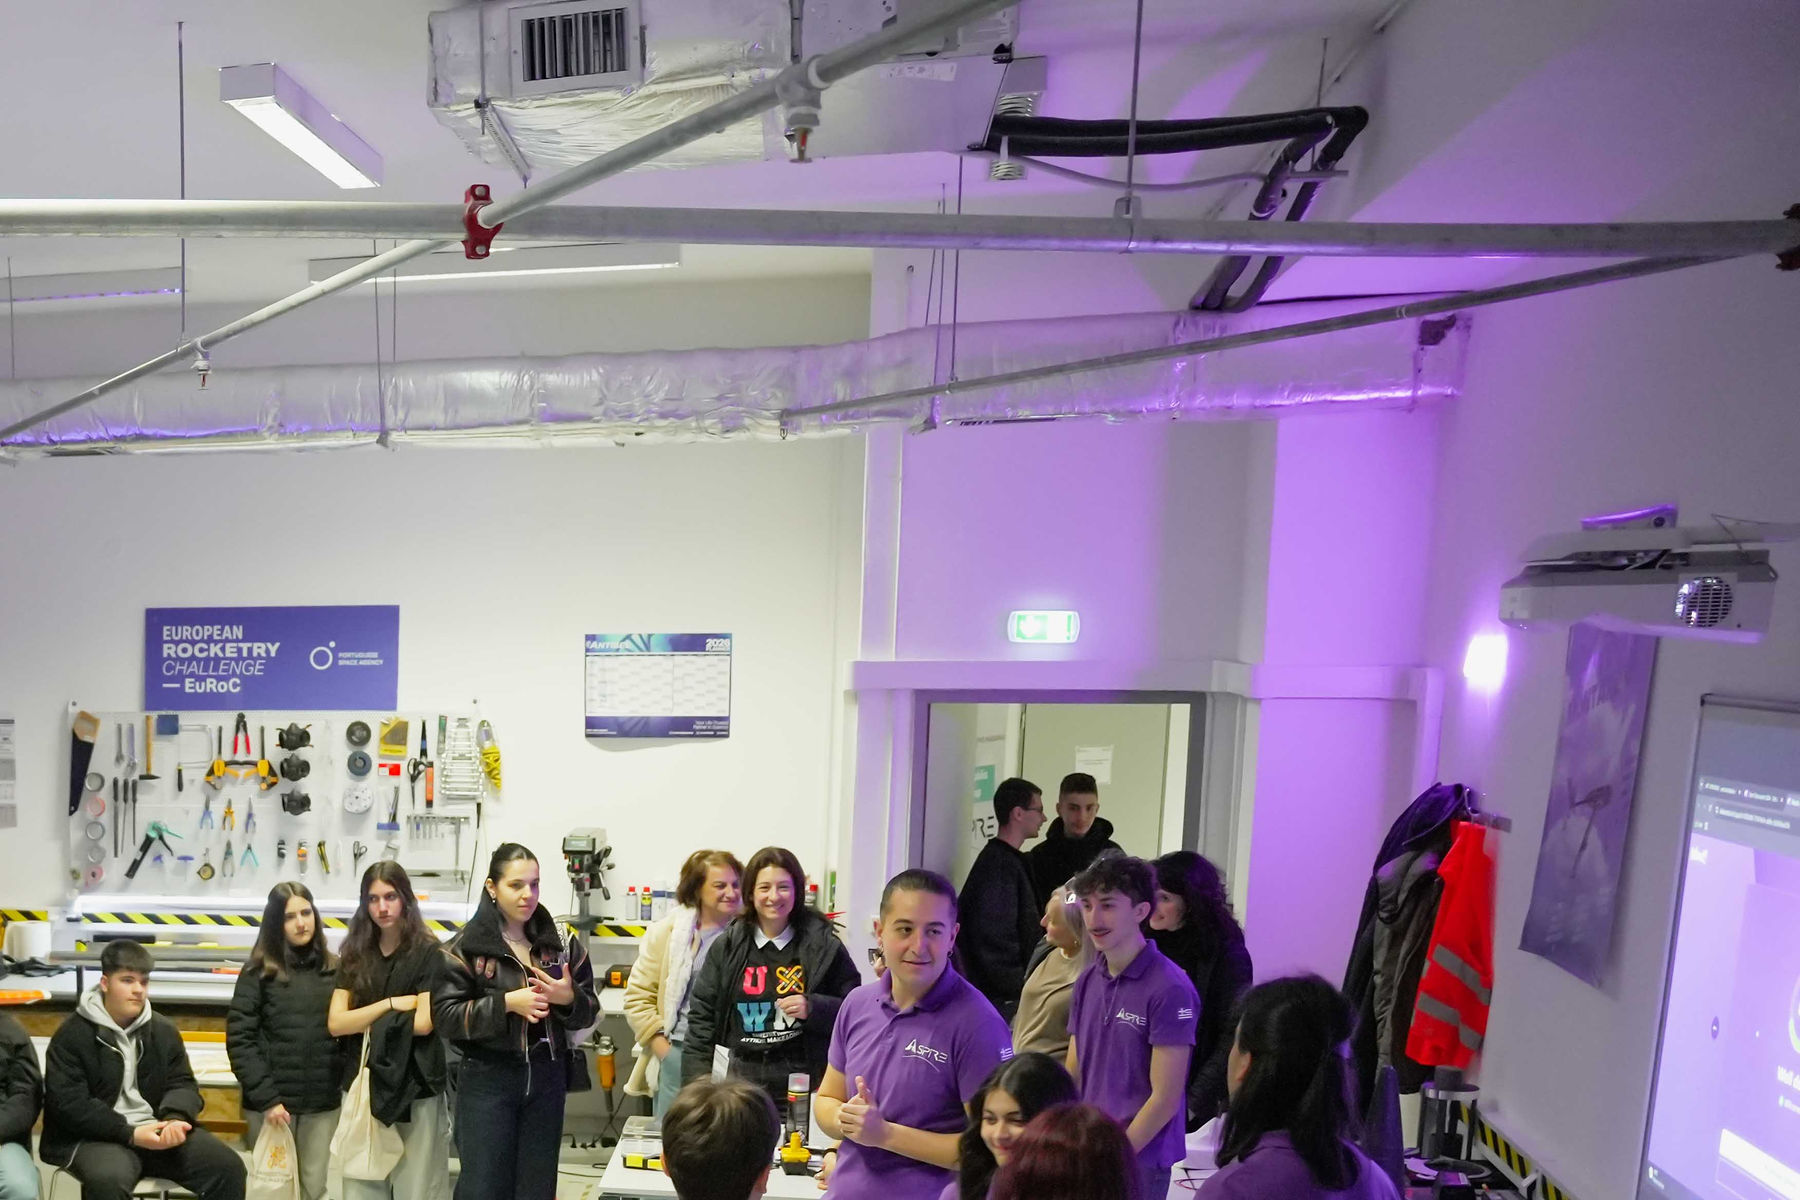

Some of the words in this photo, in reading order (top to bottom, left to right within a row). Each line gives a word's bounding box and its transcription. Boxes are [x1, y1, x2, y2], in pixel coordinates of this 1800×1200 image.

[162, 625, 243, 640] EUROPEAN
[162, 642, 281, 658] ROCKETRY
[162, 660, 266, 676] CHALLENGE
[184, 678, 241, 693] EuRoC
[904, 1038, 949, 1063] ASPIRE
